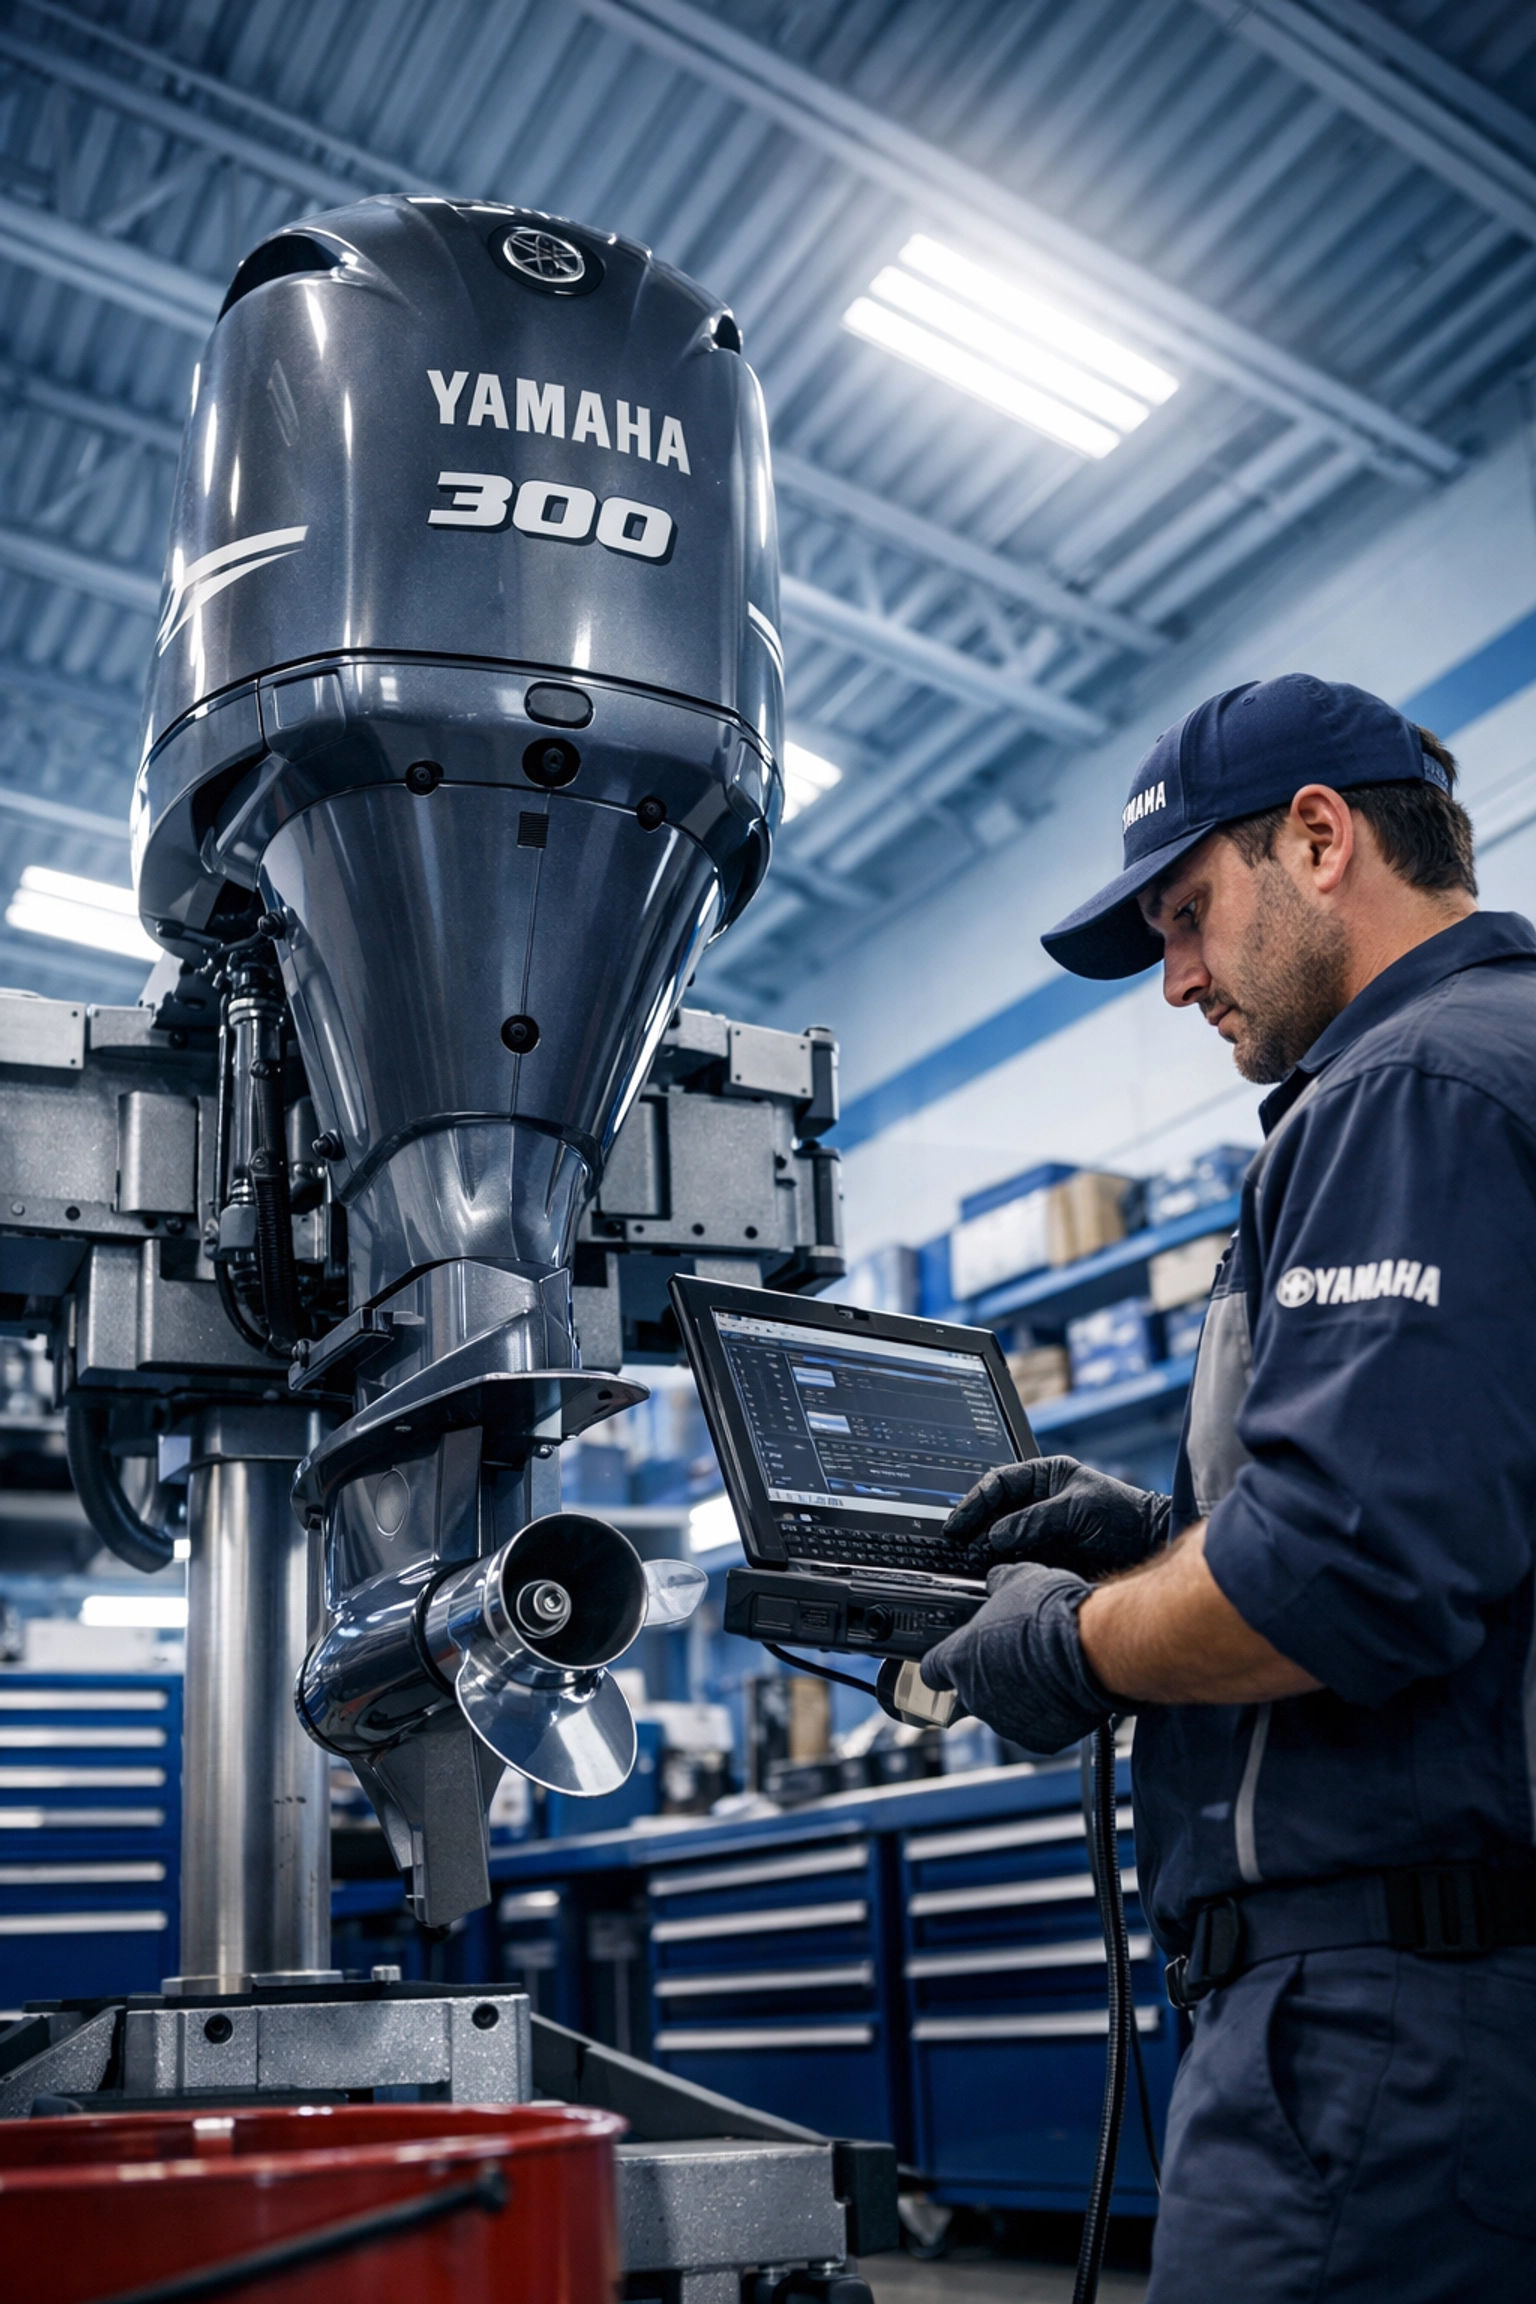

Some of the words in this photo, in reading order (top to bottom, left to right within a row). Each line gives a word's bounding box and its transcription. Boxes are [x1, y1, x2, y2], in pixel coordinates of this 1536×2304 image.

[426, 369, 691, 475] YAMAHA
[427, 471, 675, 562] 300
[1315, 1259, 1441, 1307] YAMAHA
